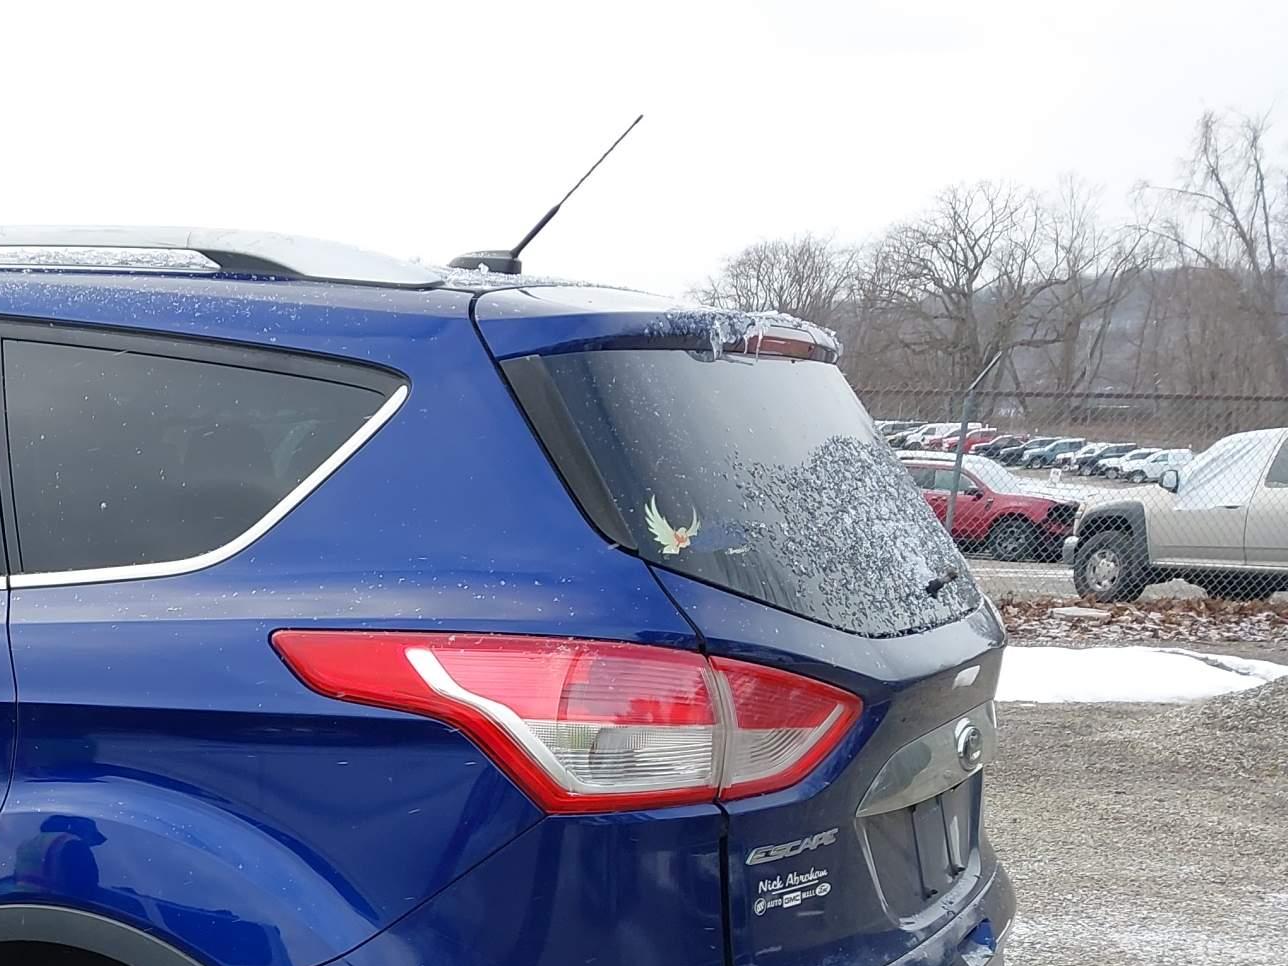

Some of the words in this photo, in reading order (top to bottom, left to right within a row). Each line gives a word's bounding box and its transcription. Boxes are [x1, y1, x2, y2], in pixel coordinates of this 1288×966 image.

[745, 827, 839, 866] ESCAPE
[758, 875, 784, 894] Nick
[785, 867, 828, 887] Abraham
[767, 898, 782, 909] AUTO
[784, 894, 801, 905] GMC
